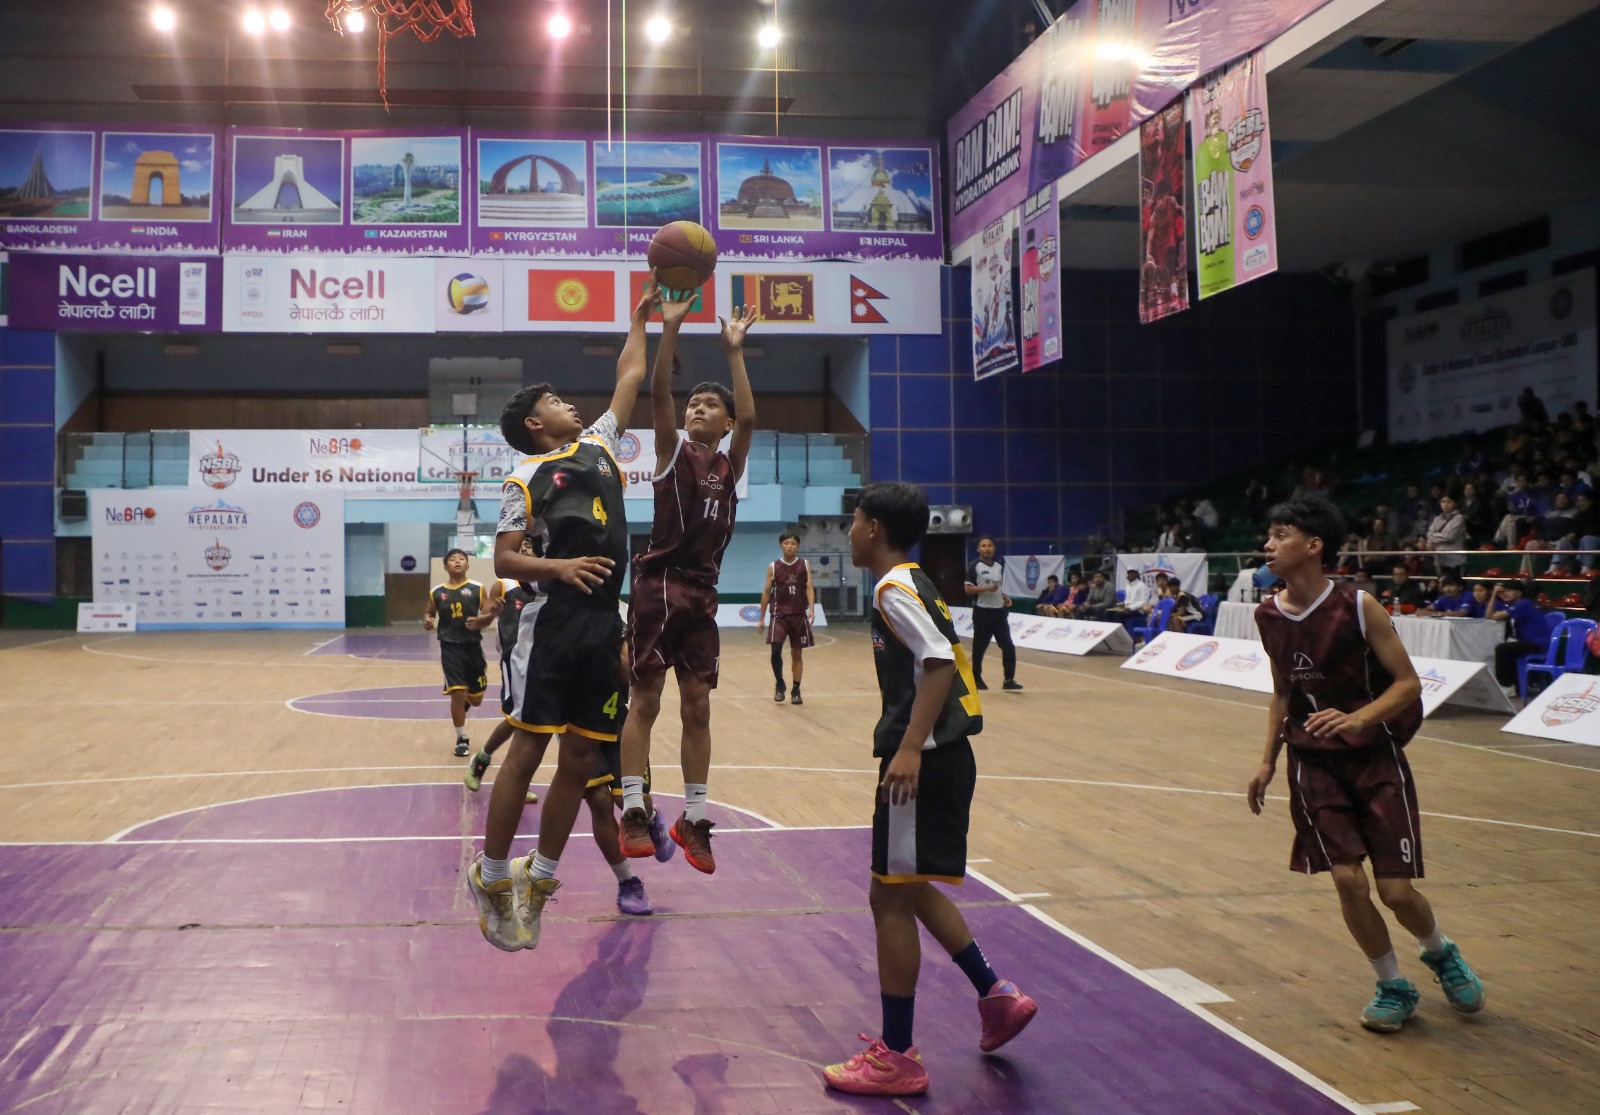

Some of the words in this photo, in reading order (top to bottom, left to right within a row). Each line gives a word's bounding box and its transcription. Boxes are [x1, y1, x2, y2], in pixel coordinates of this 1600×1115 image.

[956, 120, 984, 192] BAM
[986, 90, 1022, 170] BAM!
[955, 168, 995, 213] HYDRATION
[995, 150, 1021, 184] DRINK
[6, 225, 77, 234] BANGLADESH
[146, 226, 178, 236] INDIA
[282, 229, 307, 238] IRAN
[379, 229, 448, 239] KAZAKHSTAN
[504, 232, 577, 241] KYRGYZSTAN
[753, 234, 769, 243] SRI
[771, 235, 804, 244] LANKA
[873, 237, 907, 246] NEPAL
[59, 265, 156, 298] Ncell
[290, 268, 385, 299] Ncell
[58, 300, 115, 319] नेपालकै
[119, 303, 156, 320] लागि
[289, 303, 345, 320] नेपालकै
[350, 305, 386, 321] लागि
[310, 438, 348, 454] NeBA
[200, 458, 241, 471] NSBL
[252, 467, 310, 483] Under
[315, 469, 333, 482] 16
[105, 507, 144, 522] NeBA
[592, 496, 608, 526] 4
[703, 497, 720, 521] 14
[188, 514, 248, 525] NEPALAYA
[788, 585, 797, 595] 12
[449, 602, 463, 618] 12
[602, 691, 619, 720] 4
[1400, 838, 1412, 863] 9
